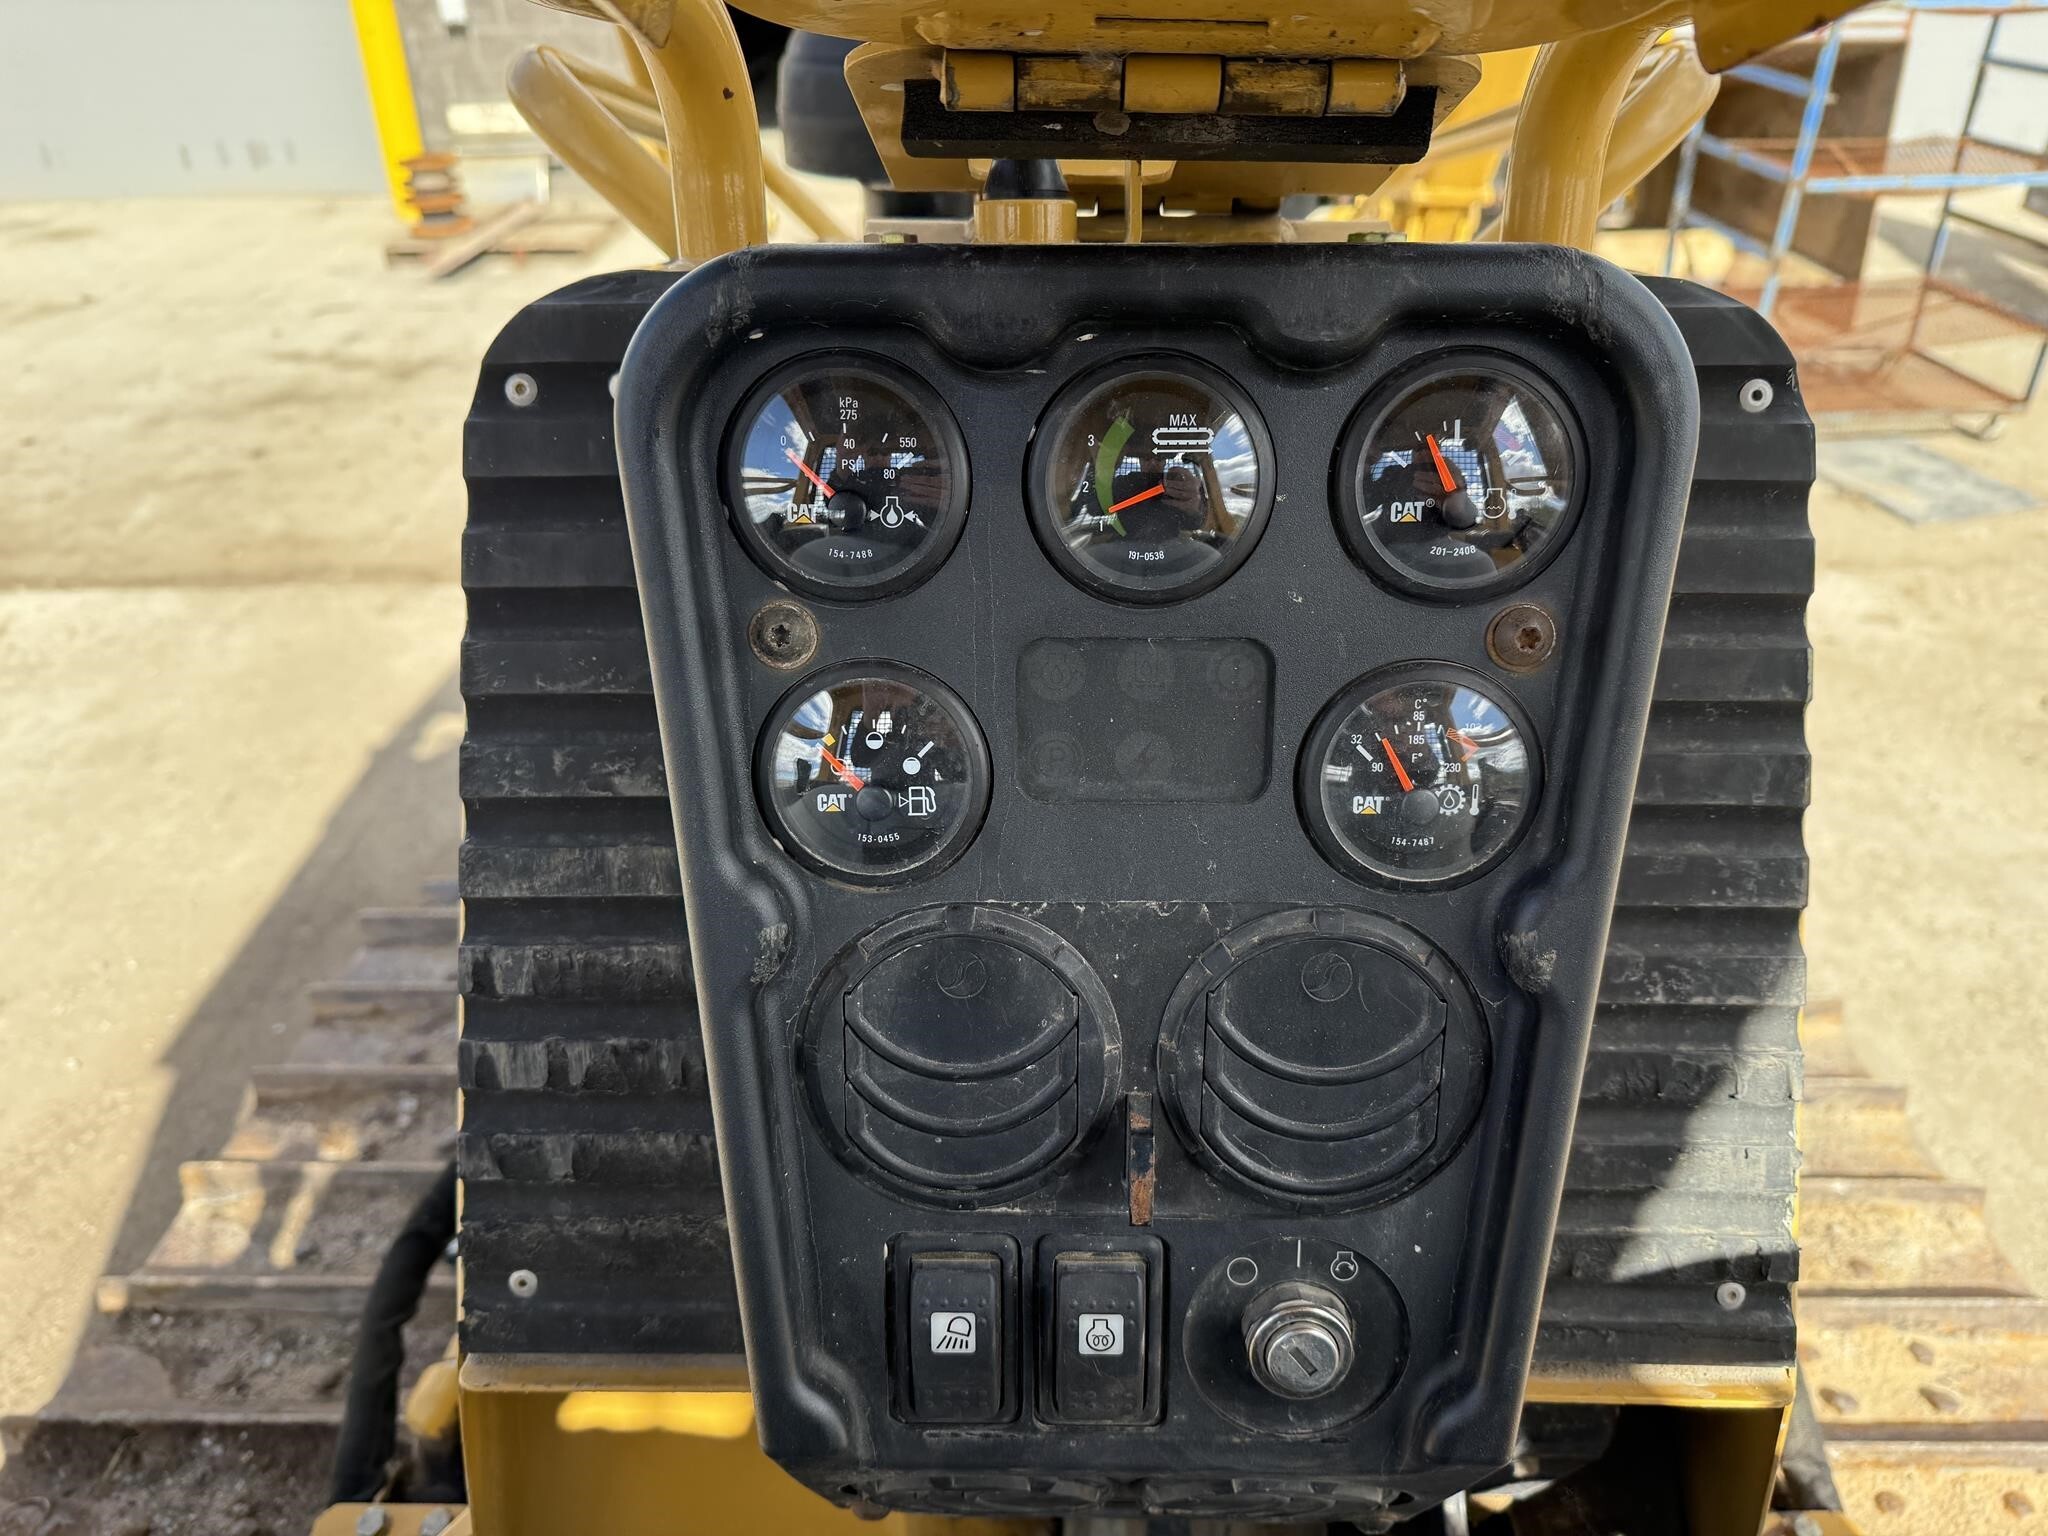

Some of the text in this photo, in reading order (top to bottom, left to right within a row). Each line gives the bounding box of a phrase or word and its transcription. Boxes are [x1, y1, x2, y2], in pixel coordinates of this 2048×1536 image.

[839, 397, 859, 410] kPa
[839, 410, 858, 421] 275
[1169, 414, 1197, 426] MAX
[780, 436, 787, 447] 0
[843, 438, 856, 449] 40
[899, 437, 917, 448] 550
[1087, 434, 1095, 447] 3
[883, 469, 896, 480] 80
[1082, 480, 1089, 493] 2
[1099, 520, 1104, 532] 1
[828, 548, 873, 559] 154-7488
[1128, 550, 1165, 561] 191-0538
[1429, 545, 1477, 557] 201-2408
[1413, 711, 1425, 721] 85
[1350, 734, 1363, 745] 32
[1408, 734, 1425, 745] 185
[1371, 762, 1384, 773] 90
[1444, 763, 1461, 773] 230
[857, 833, 900, 843] 153-0455
[1391, 836, 1434, 847] 154-7487
